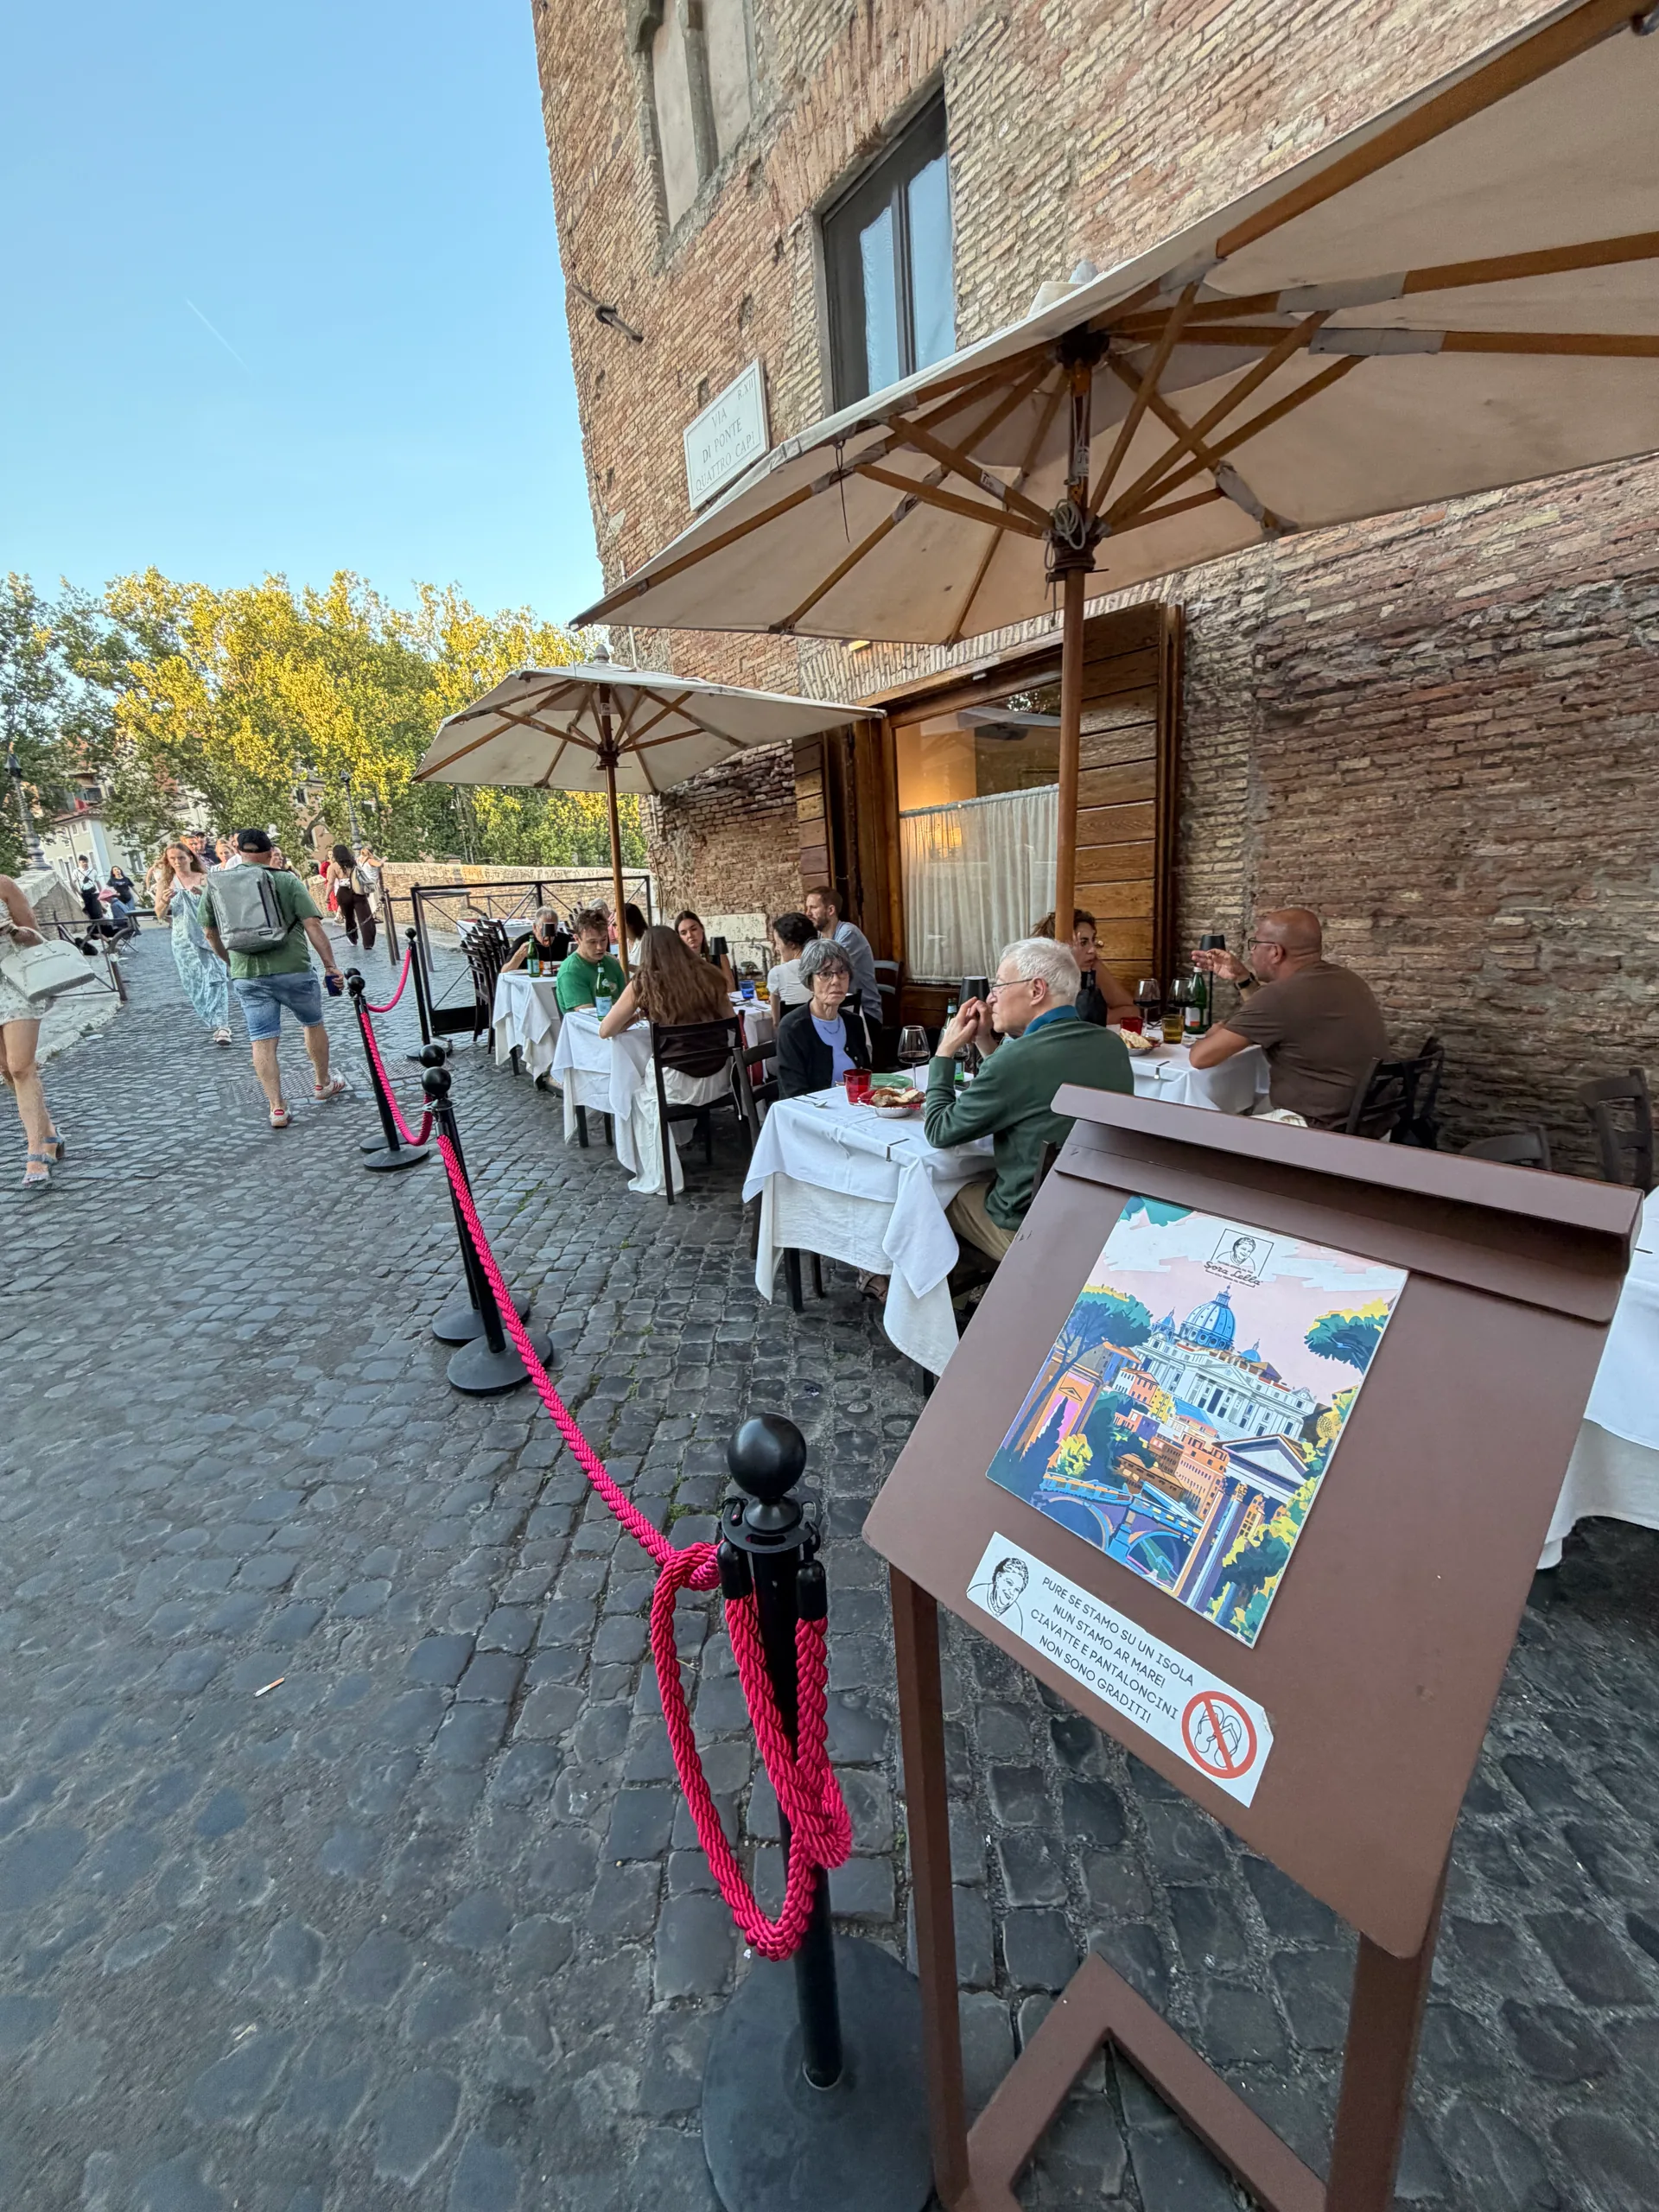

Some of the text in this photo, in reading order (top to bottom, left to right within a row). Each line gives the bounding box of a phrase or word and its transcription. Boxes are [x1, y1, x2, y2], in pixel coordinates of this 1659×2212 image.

[702, 417, 742, 463] DI PONTE
[711, 407, 728, 428] VIA
[696, 430, 755, 491] QUATTRO CAPI
[1204, 1261, 1229, 1274] Sora
[1230, 1271, 1261, 1286] Lella
[1031, 1609, 1179, 1720] CIAVATTE E PANTALONCINI
[1042, 1576, 1194, 1686] PURE SE STAMO SU UN ISOLA
[1053, 1604, 1166, 1688] NUN STAMO AR MARE!
[1039, 1635, 1151, 1723] NON SONO GRADITI!
